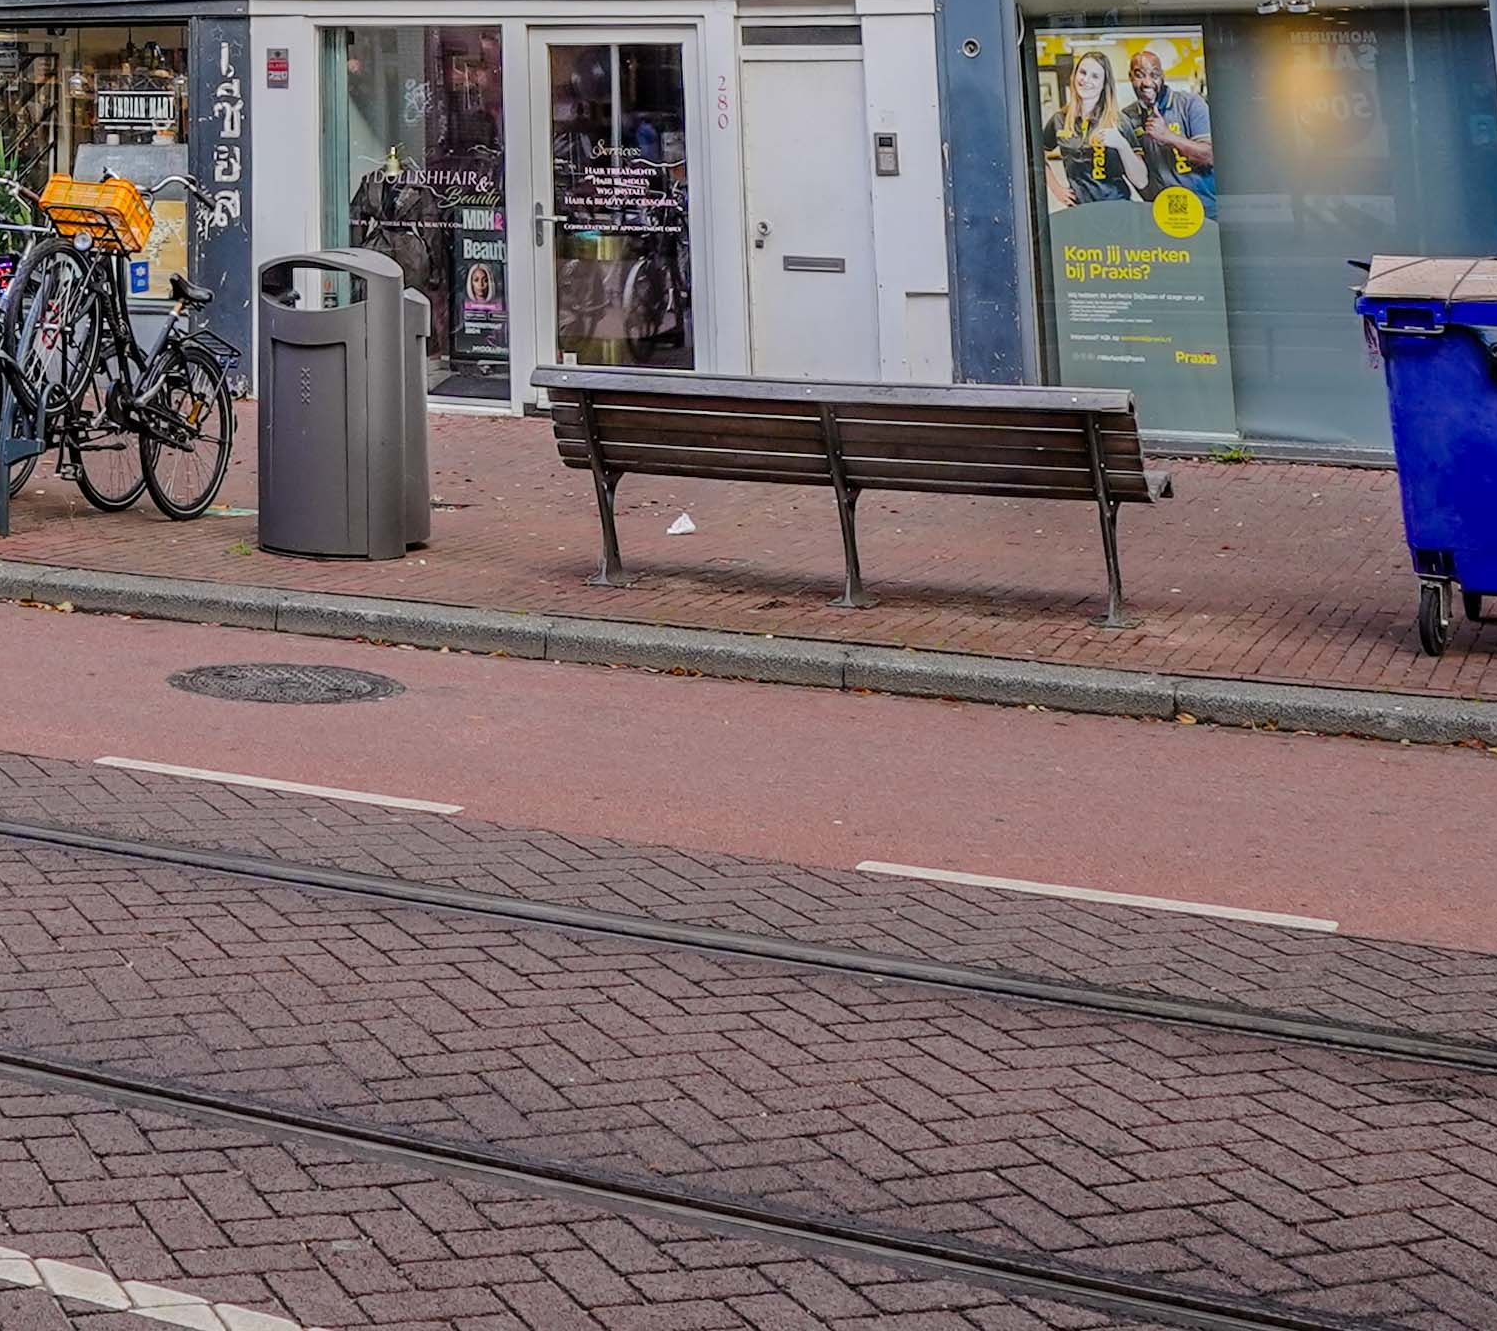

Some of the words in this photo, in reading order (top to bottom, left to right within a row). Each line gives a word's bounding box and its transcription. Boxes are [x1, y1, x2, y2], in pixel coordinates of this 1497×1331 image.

[113, 96, 146, 119] INDIAN
[584, 166, 605, 176] HAIR
[437, 186, 501, 209] Beauty
[564, 196, 585, 206] HAIR
[1064, 245, 1103, 262] Kom
[1106, 245, 1121, 265] jij
[1124, 247, 1191, 264] werken
[1065, 263, 1086, 282] bij
[1089, 264, 1151, 280] Praxis?
[1174, 350, 1218, 365] Praxis
